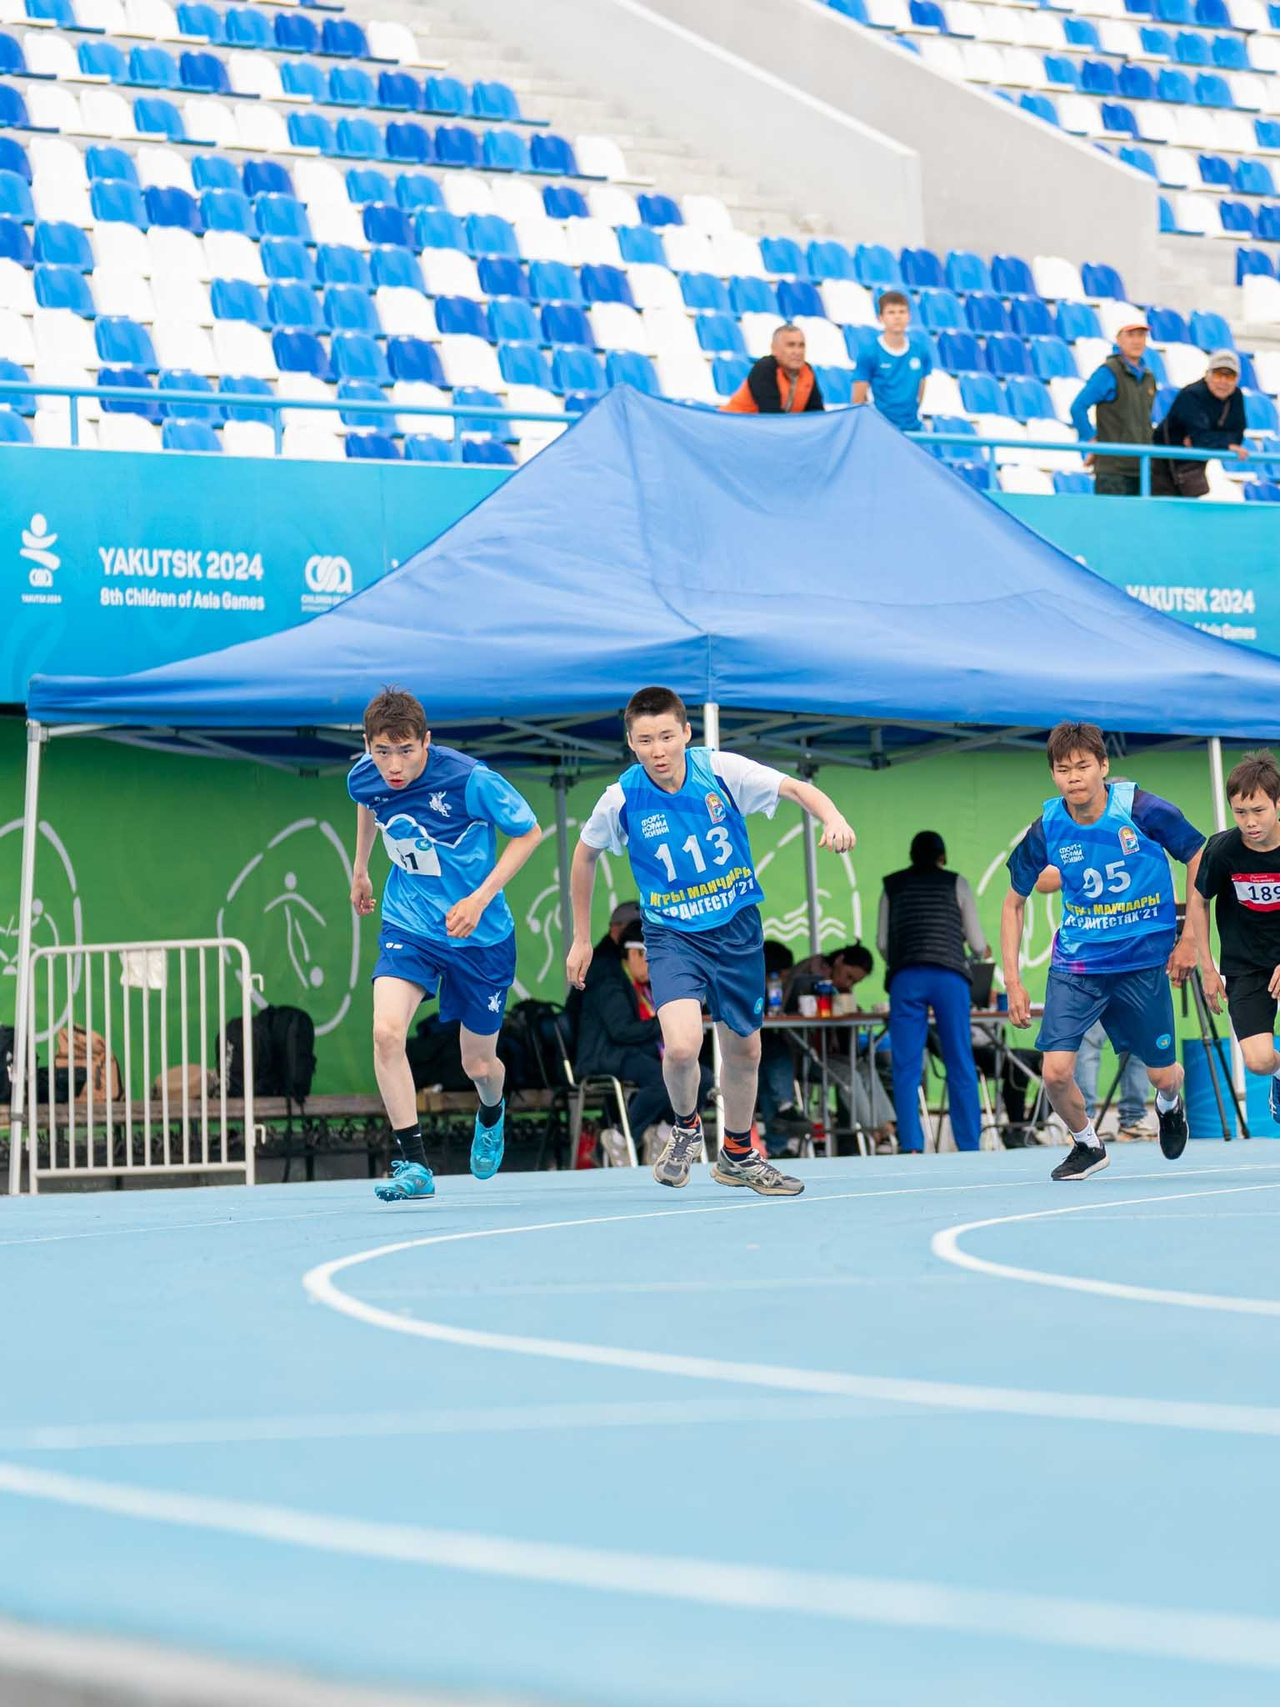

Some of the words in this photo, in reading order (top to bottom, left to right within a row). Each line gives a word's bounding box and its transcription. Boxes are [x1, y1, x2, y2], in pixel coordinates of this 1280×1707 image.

[99, 547, 203, 578] YAKUTSK
[206, 550, 264, 580] 2024
[100, 587, 123, 606] 8th
[125, 587, 176, 608] Children
[178, 589, 193, 608] of
[193, 591, 220, 609] Asia
[222, 591, 265, 611] Games
[1209, 587, 1256, 614] 2024
[654, 826, 733, 882] 113
[1082, 860, 1132, 899] 95
[650, 889, 686, 907] ИГРЫ
